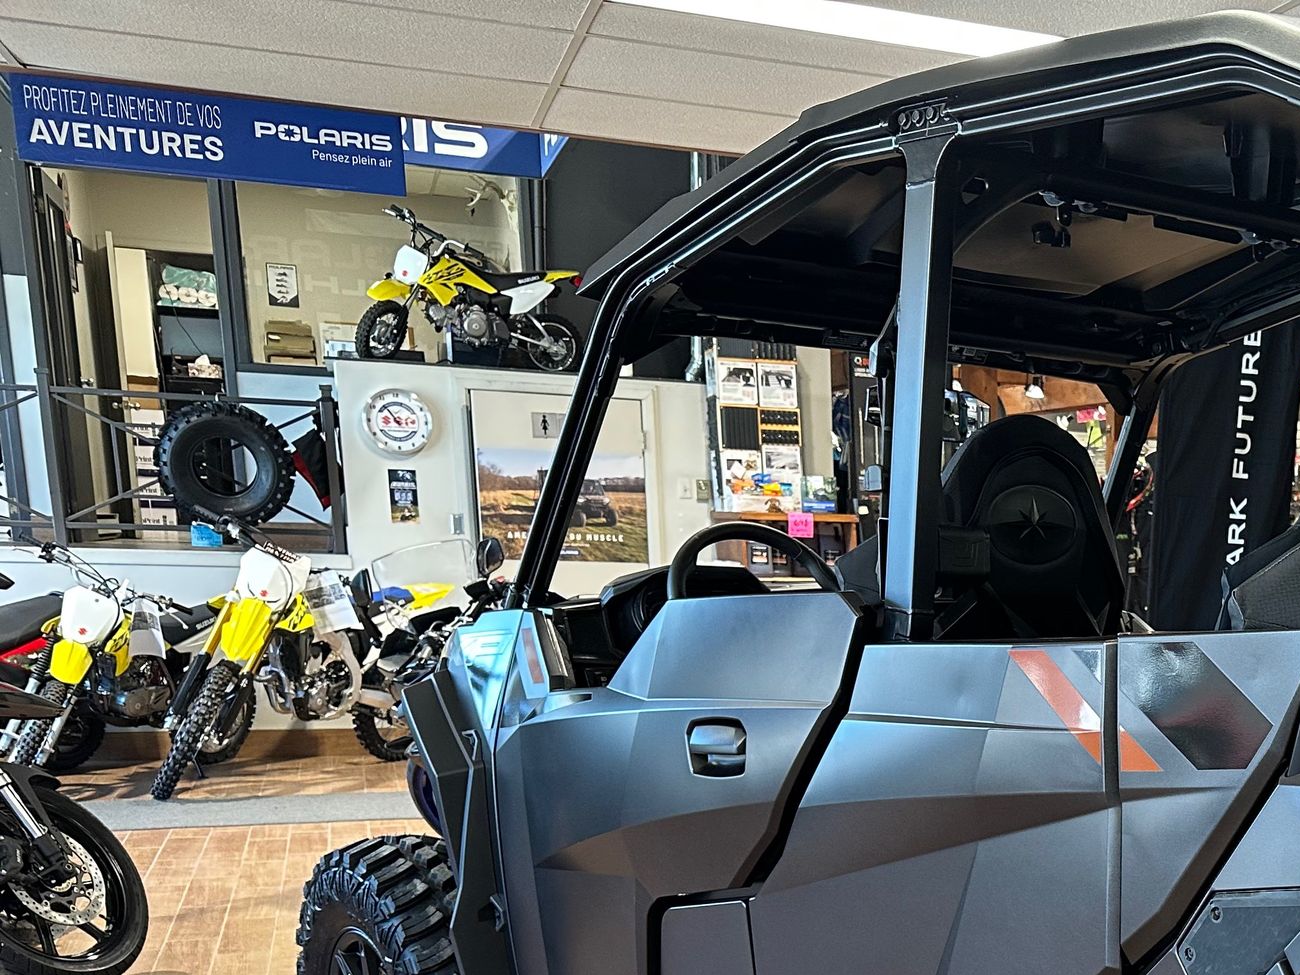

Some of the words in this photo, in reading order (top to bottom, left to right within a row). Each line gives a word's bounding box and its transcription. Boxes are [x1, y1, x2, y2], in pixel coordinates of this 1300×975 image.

[23, 84, 87, 115] PROFITEZ
[91, 92, 172, 123] PLEINEMENT
[176, 101, 194, 126] DE
[196, 104, 222, 129] VOS
[29, 118, 224, 161] AVENTURES
[254, 120, 392, 151] POLARIS
[312, 149, 350, 163] Pensez
[352, 154, 377, 167] plein
[379, 157, 392, 168] air
[1231, 330, 1262, 480] FUTURE
[586, 534, 624, 542] MUSCLE
[1225, 498, 1248, 566] ARK
